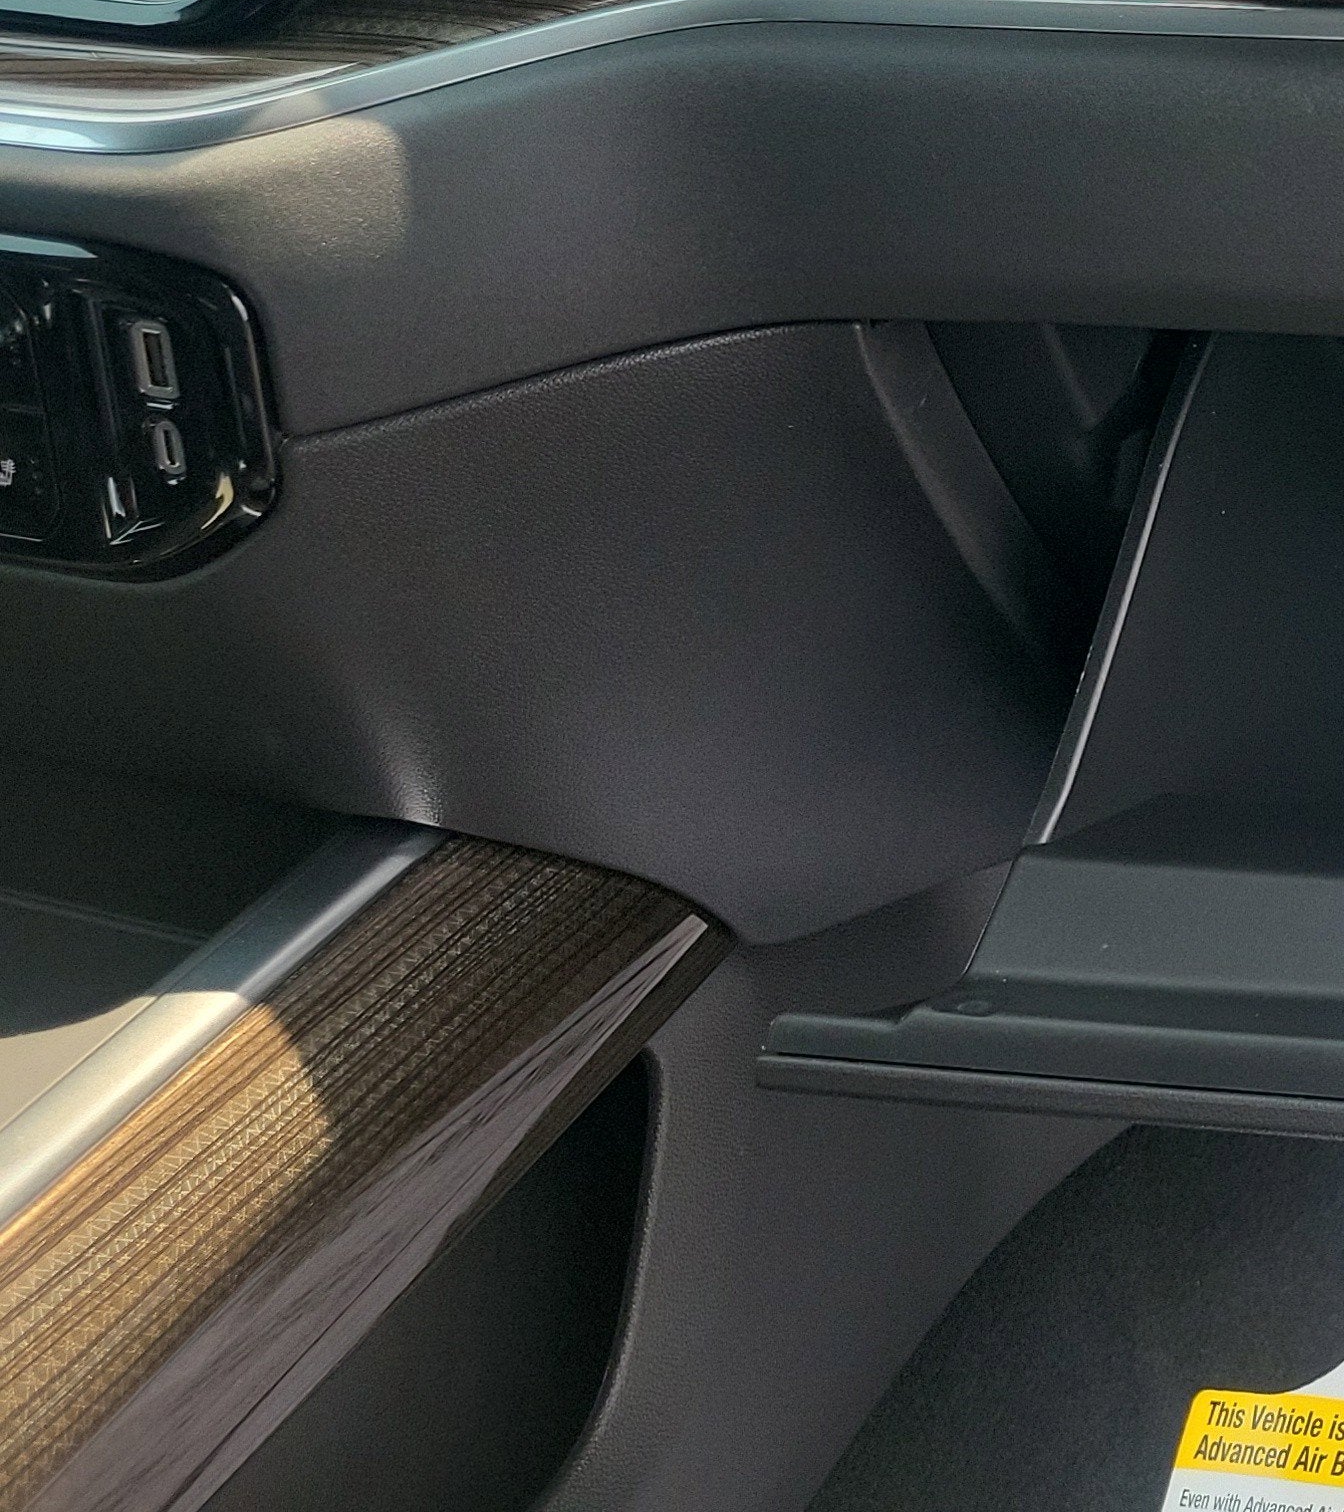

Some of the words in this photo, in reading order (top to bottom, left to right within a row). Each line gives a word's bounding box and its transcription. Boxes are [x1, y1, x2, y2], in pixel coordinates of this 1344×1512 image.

[1207, 1400, 1245, 1429] This
[1252, 1404, 1324, 1438] Vehicle
[1193, 1434, 1292, 1469] Advanced
[1293, 1445, 1328, 1474] Air
[1180, 1489, 1210, 1509] Even
[1213, 1494, 1241, 1512] with
